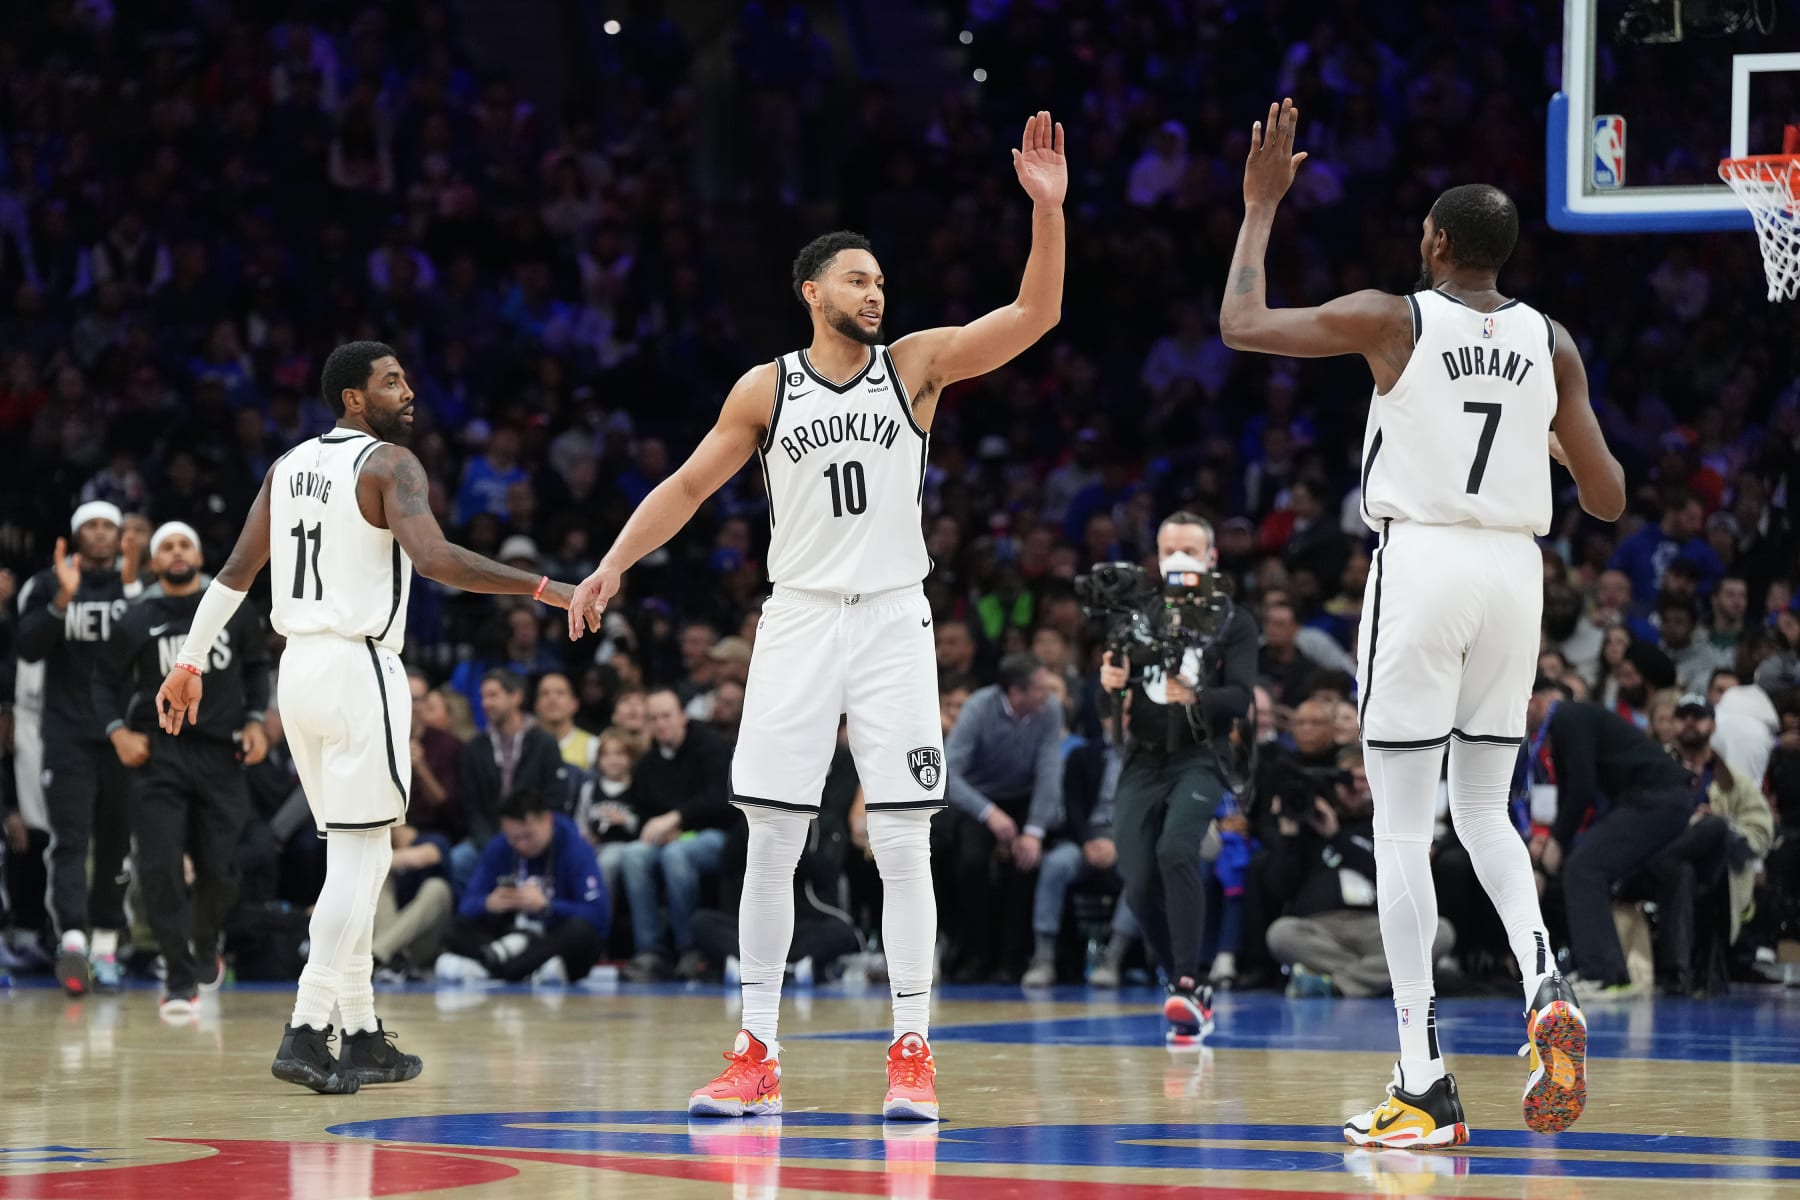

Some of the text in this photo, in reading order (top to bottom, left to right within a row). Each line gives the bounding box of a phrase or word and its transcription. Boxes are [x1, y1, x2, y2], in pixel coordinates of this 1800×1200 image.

[791, 374, 801, 385] 6
[868, 386, 889, 394] Webull
[1442, 346, 1534, 386] DURANT
[781, 413, 901, 464] BROOKLYN
[1463, 401, 1502, 494] 7
[823, 461, 868, 518] 10
[290, 518, 323, 601] 11
[158, 628, 232, 677] NS
[911, 750, 941, 768] NETS
